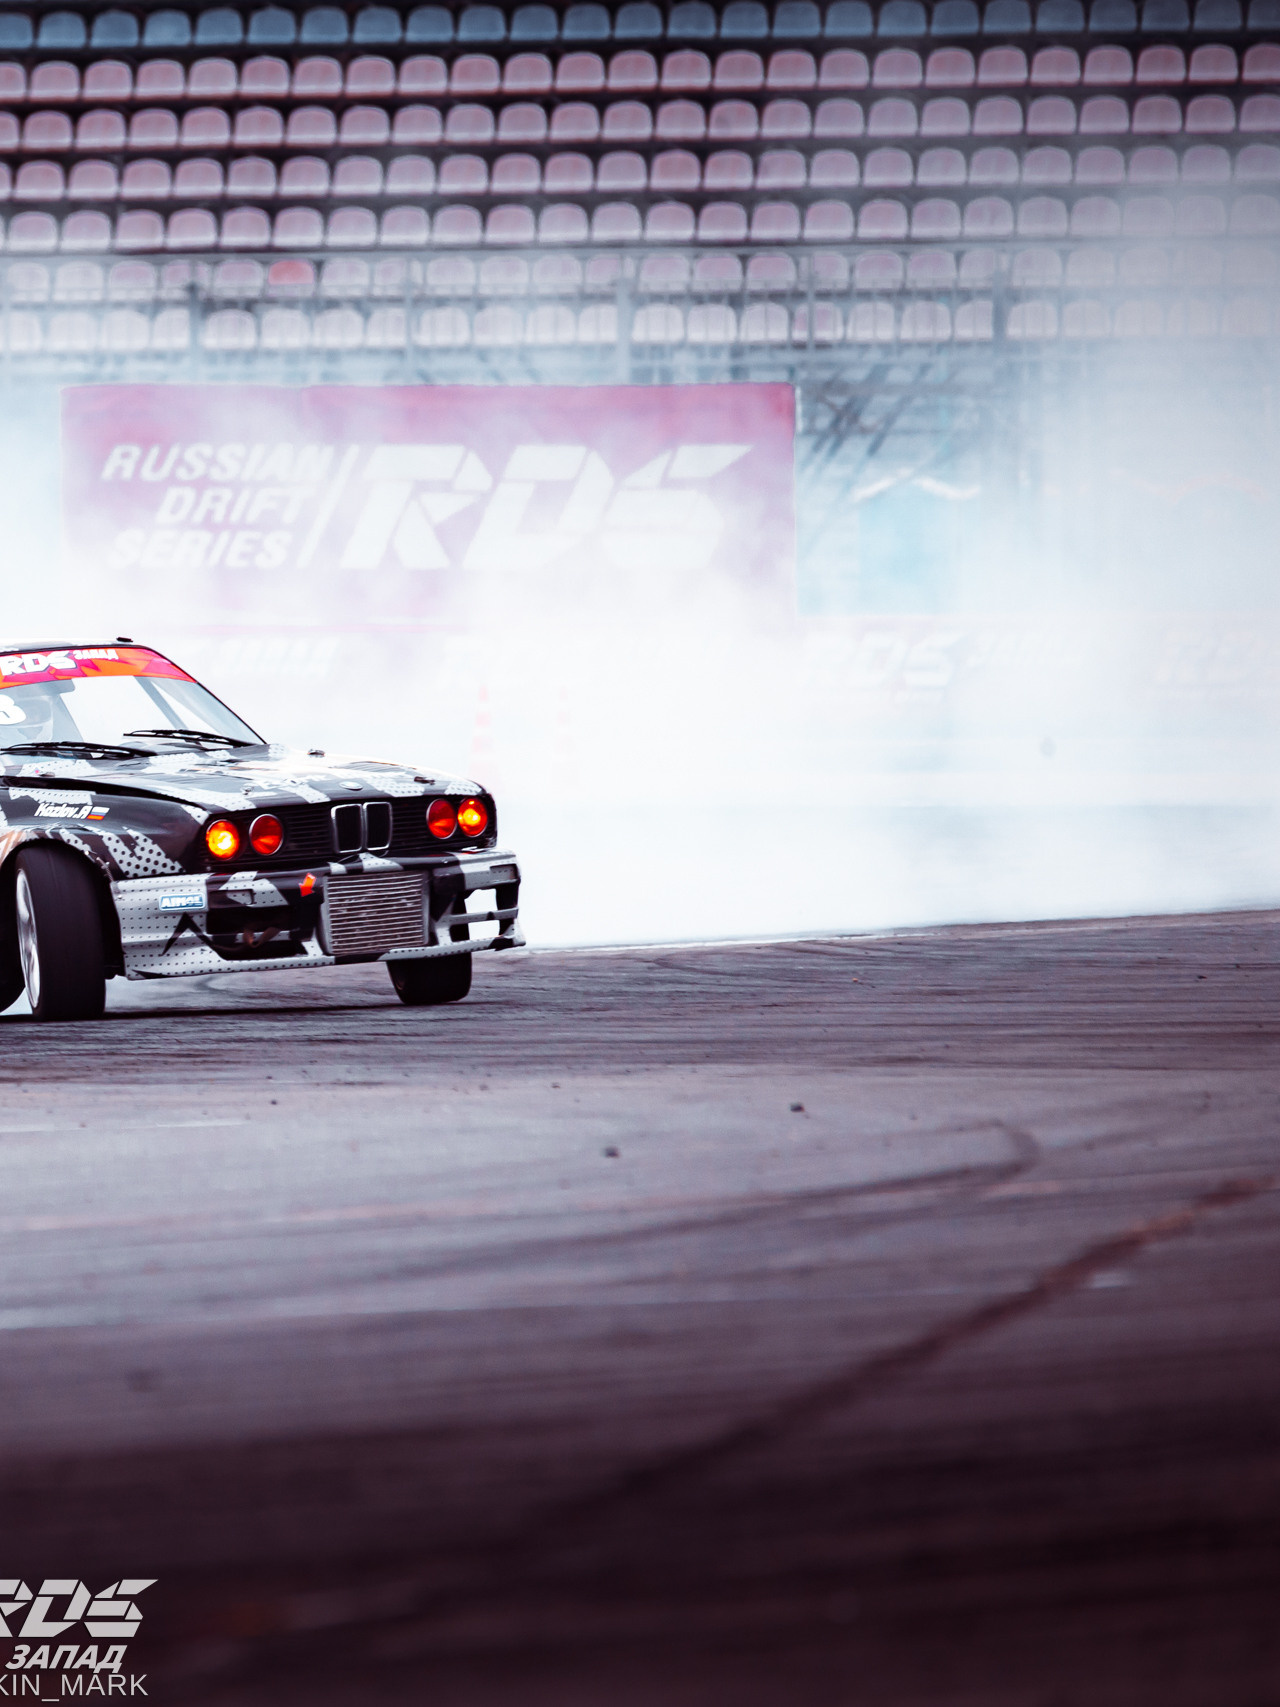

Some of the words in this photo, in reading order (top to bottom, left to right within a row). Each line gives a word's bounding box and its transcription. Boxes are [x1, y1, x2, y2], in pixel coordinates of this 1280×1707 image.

[102, 444, 339, 482] RUSSIAN
[156, 486, 320, 525] DRIFT
[342, 443, 754, 569] RDS
[106, 530, 294, 569] SERIES
